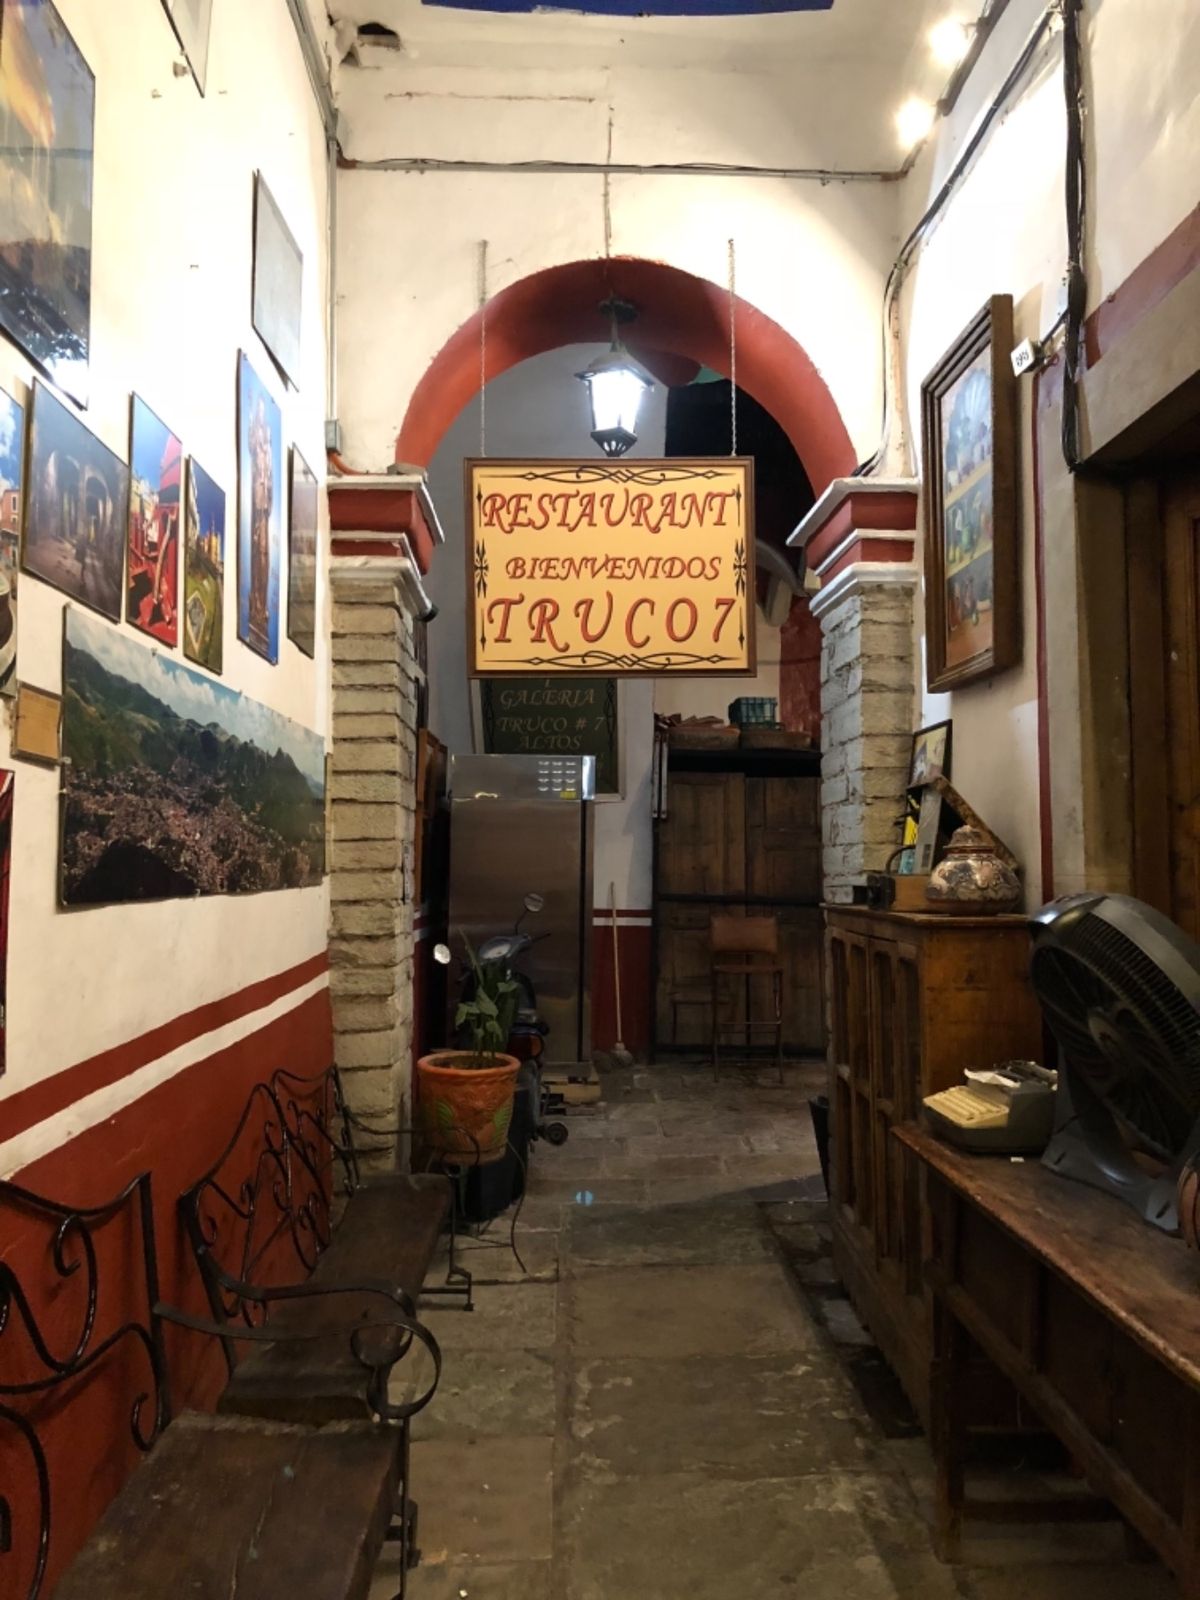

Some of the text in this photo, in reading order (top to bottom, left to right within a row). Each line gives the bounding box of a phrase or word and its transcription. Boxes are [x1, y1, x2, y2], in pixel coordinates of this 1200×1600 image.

[482, 487, 736, 534] RESTAURANT
[505, 554, 722, 580] BIENVENIDOS
[500, 688, 595, 709] GALERIA
[497, 715, 568, 734] TRUCO
[594, 717, 605, 731] 7
[520, 735, 583, 750] ALTOS
